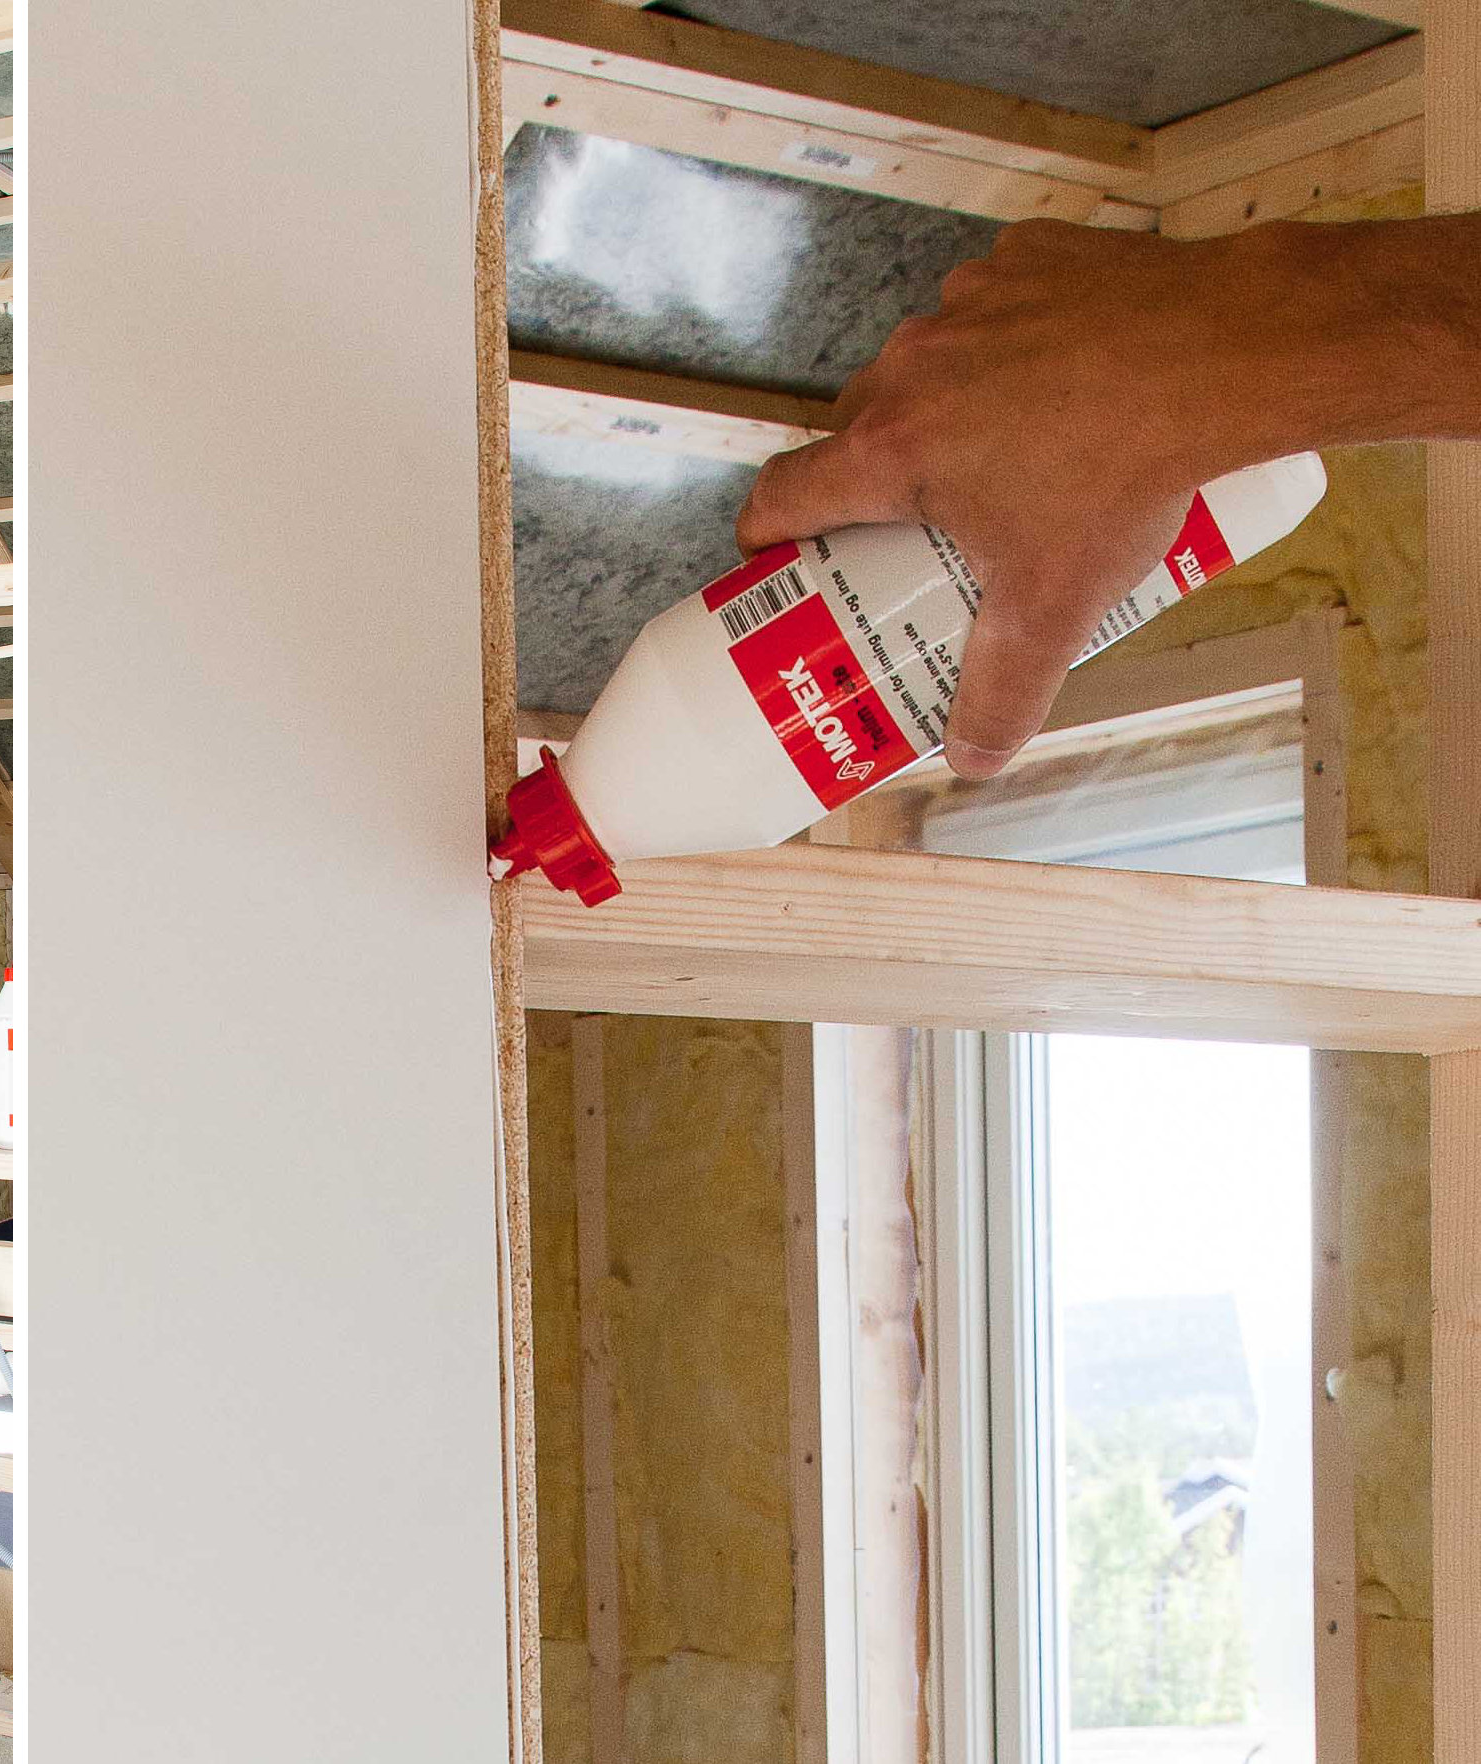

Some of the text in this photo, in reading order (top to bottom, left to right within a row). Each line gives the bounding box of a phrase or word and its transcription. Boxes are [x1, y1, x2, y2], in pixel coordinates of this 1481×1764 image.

[828, 569, 851, 596] inne
[843, 593, 862, 613] og
[853, 612, 873, 634] ute
[901, 621, 919, 641] ute
[865, 633, 895, 673] liming
[913, 639, 929, 656] og
[921, 655, 940, 679] inne
[886, 672, 905, 692] for
[777, 654, 857, 763] MOTEK
